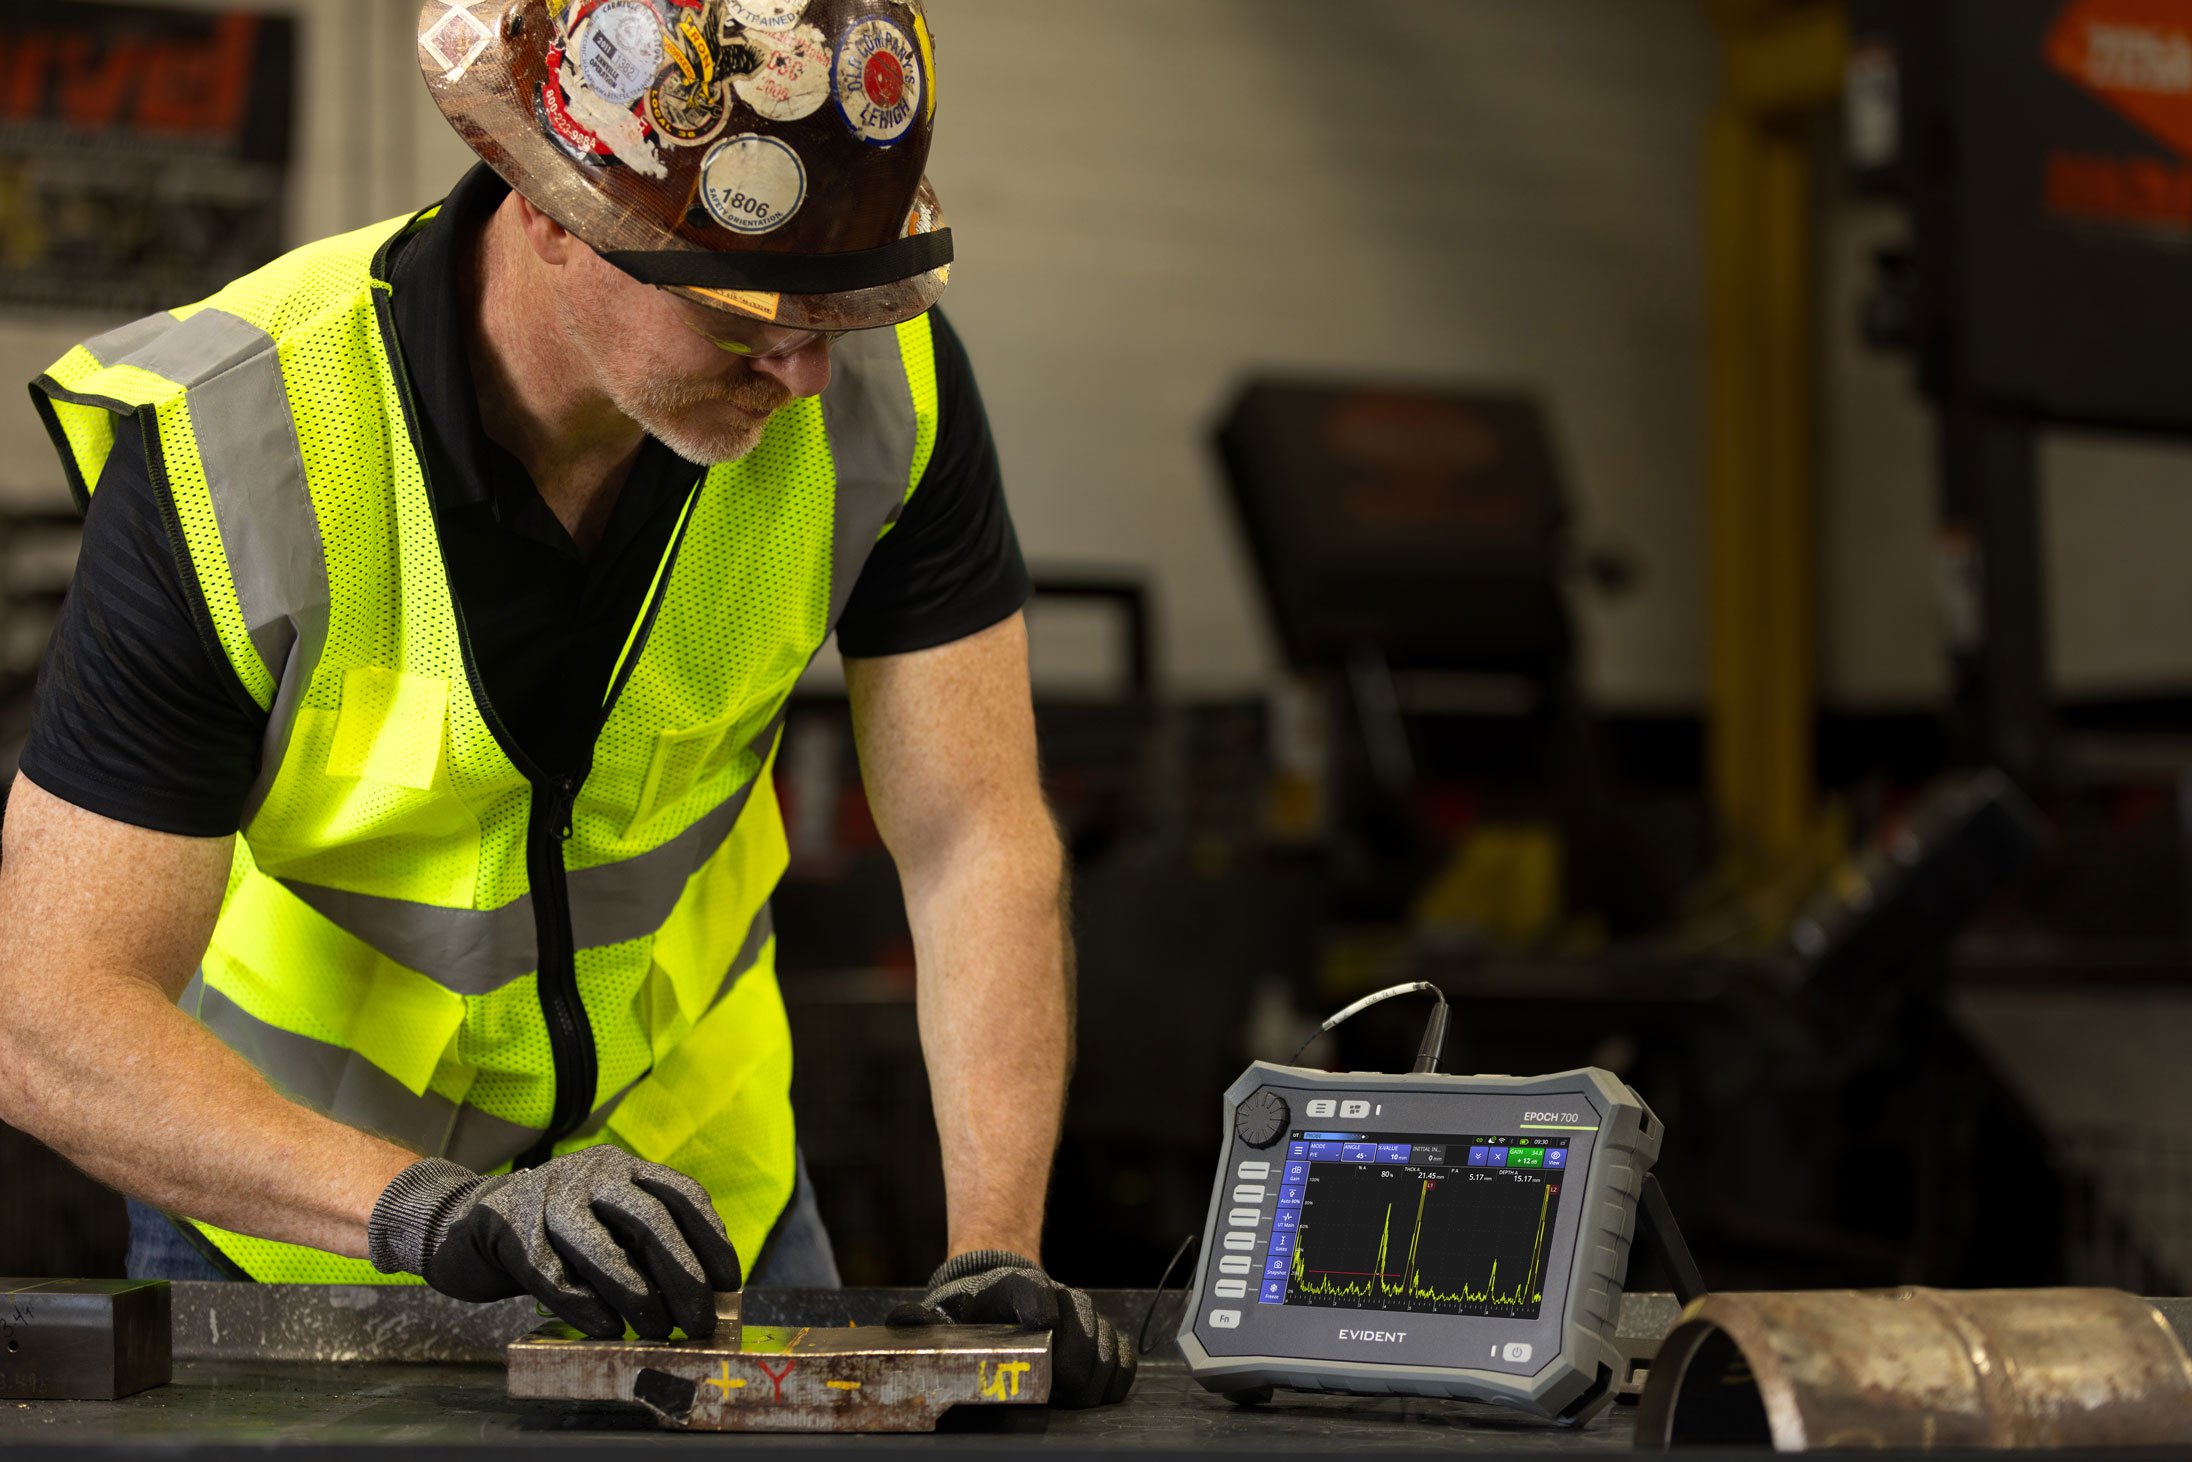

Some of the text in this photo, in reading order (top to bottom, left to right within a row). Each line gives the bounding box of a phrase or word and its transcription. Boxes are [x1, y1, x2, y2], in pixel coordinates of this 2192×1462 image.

[745, 11, 796, 27] TRAINED
[596, 36, 612, 54] 2011
[686, 24, 711, 70] IRON
[589, 58, 618, 89] OPERATION
[595, 53, 620, 81] ANNVILLE
[664, 41, 695, 81] WORKERS
[846, 57, 863, 92] OLD
[651, 90, 672, 132] LOCAL
[677, 130, 696, 139] 36
[859, 98, 911, 129] LEHIGH
[709, 187, 783, 227] SAFETY ORIENTATION
[722, 188, 770, 219] 1806
[1524, 1112, 1579, 1123] EPOCH 700
[1291, 1165, 1302, 1174] dB
[1219, 1314, 1230, 1323] Fn
[1338, 1329, 1408, 1343] EVIDENT
[758, 1359, 797, 1404] Y
